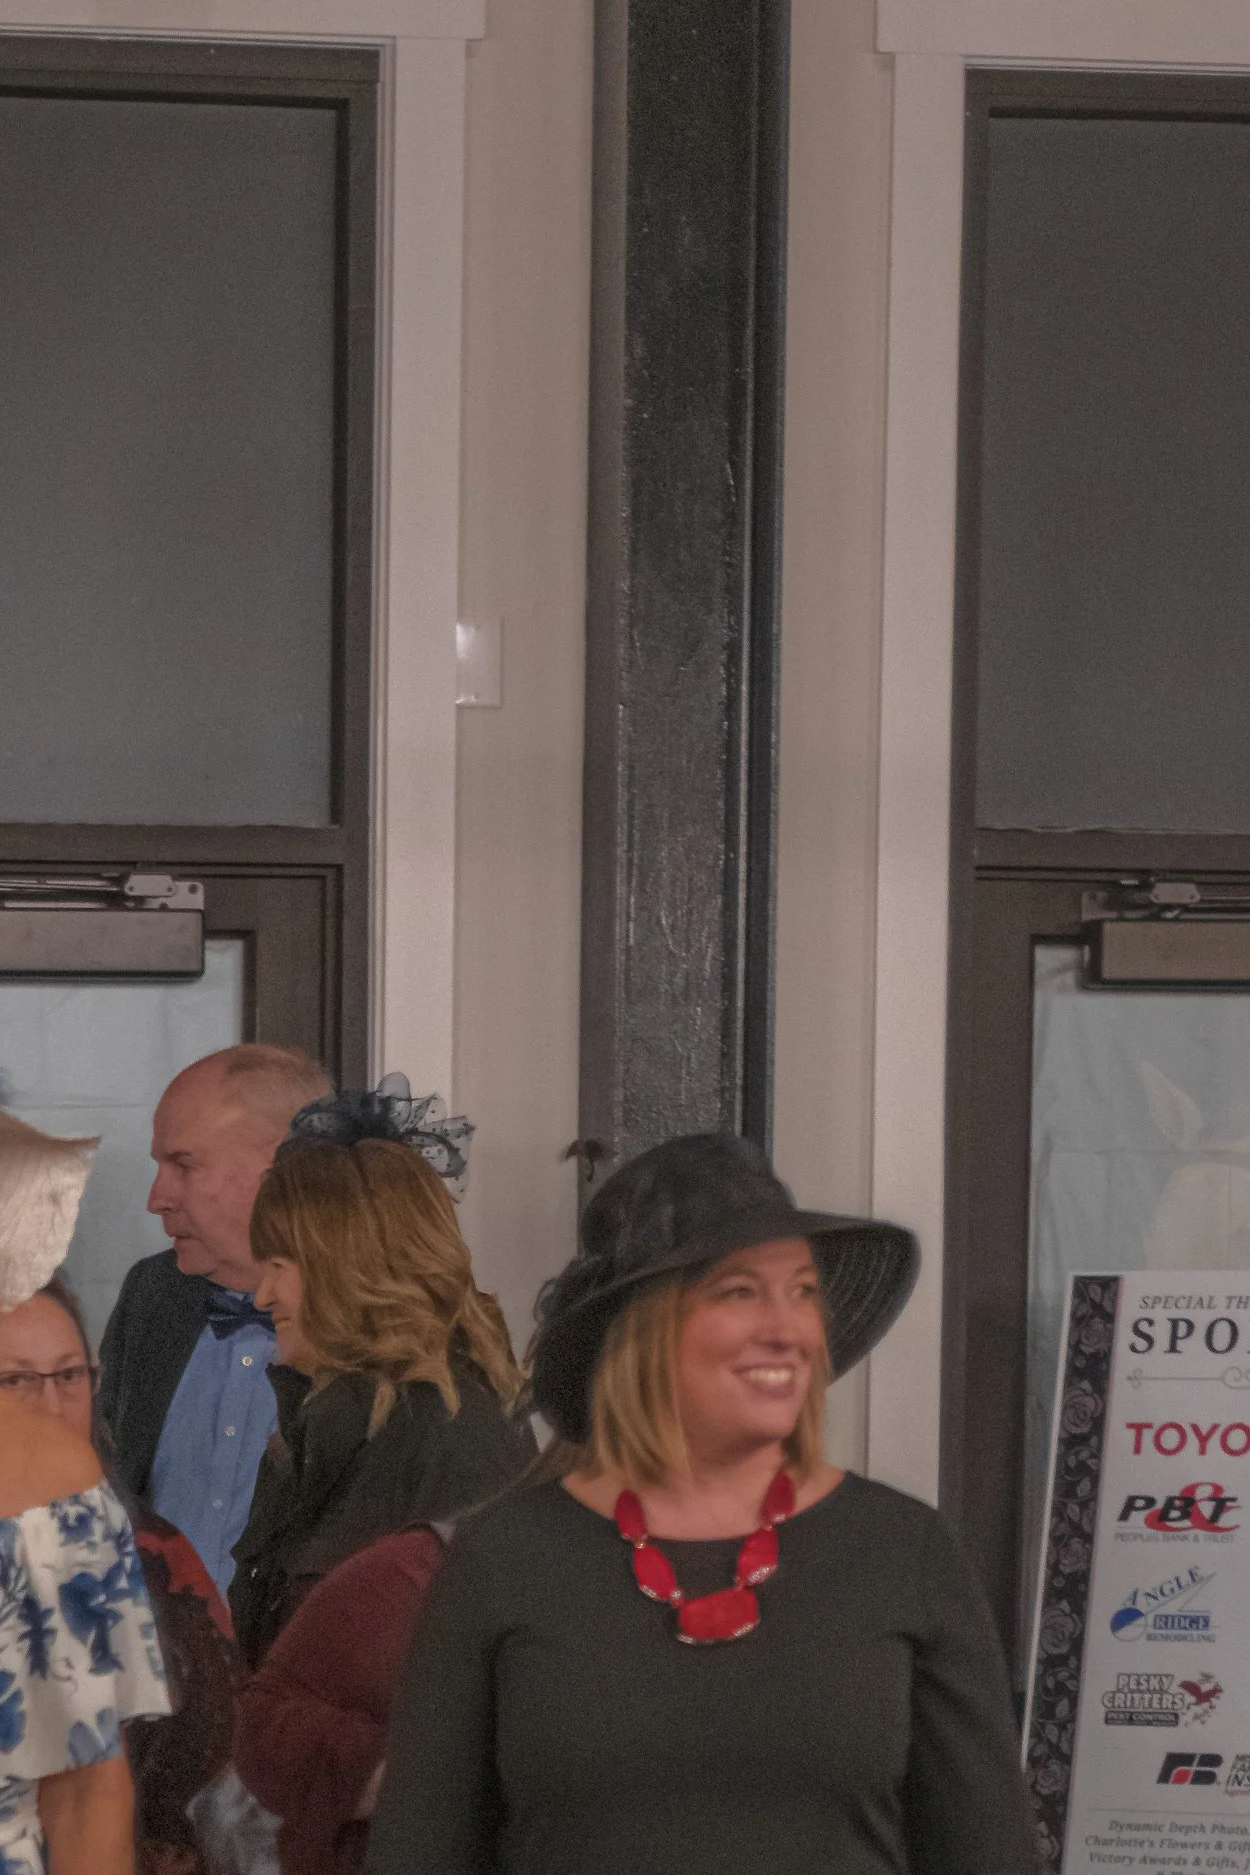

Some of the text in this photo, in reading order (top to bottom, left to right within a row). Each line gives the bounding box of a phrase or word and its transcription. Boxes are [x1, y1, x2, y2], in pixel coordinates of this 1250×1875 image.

[1139, 1295, 1216, 1311] SPECIAL
[1128, 1317, 1250, 1355] SPO
[1125, 1421, 1250, 1457] TOYO
[1122, 1565, 1204, 1609] ANGLE
[1153, 1615, 1209, 1631] RIDGE
[1117, 1673, 1174, 1692] PESKY
[1102, 1692, 1185, 1710] CRITTERS
[1107, 1712, 1176, 1721] PEST CONTROL
[1108, 1819, 1165, 1834] Dynamic
[1168, 1821, 1206, 1836] Depth
[1084, 1834, 1155, 1850] Charlotte's
[1159, 1837, 1210, 1851] Flowers
[1213, 1840, 1223, 1851] &
[1088, 1852, 1137, 1868] Victory
[1139, 1854, 1188, 1866] Awards
[1192, 1856, 1202, 1866] &
